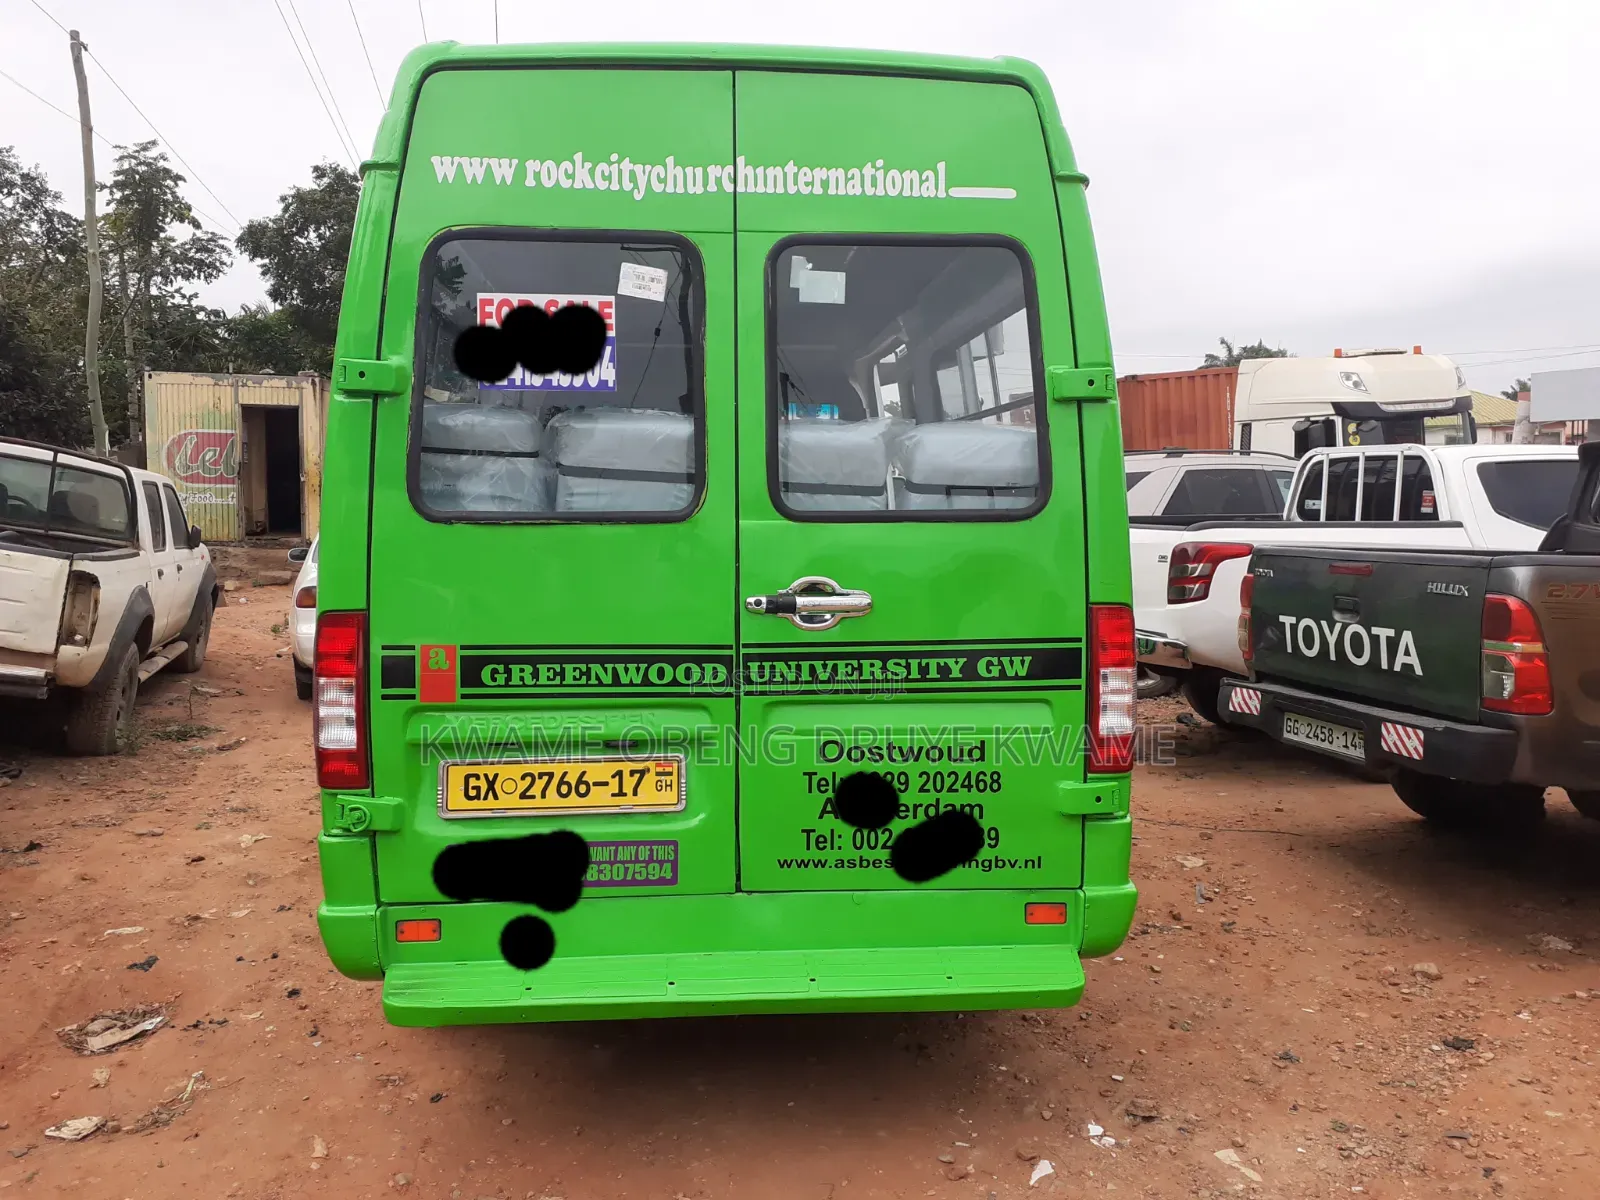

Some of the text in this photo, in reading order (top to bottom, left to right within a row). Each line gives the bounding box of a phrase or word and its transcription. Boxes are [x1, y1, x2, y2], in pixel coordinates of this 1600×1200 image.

[430, 156, 519, 186] www
[479, 298, 535, 328] FO
[1279, 615, 1424, 677] TOYOTA
[480, 655, 1033, 686] GREENWOOD UNIVERSITY GW
[819, 739, 987, 764] Oostwoud
[463, 768, 648, 801] GX 2766-17
[655, 779, 673, 793] GH
[917, 771, 1002, 794] 202468
[801, 828, 843, 851] Tel:
[616, 845, 637, 861] ANY
[638, 845, 651, 861] OF
[652, 844, 675, 861] THIS
[582, 863, 673, 882] 8307594
